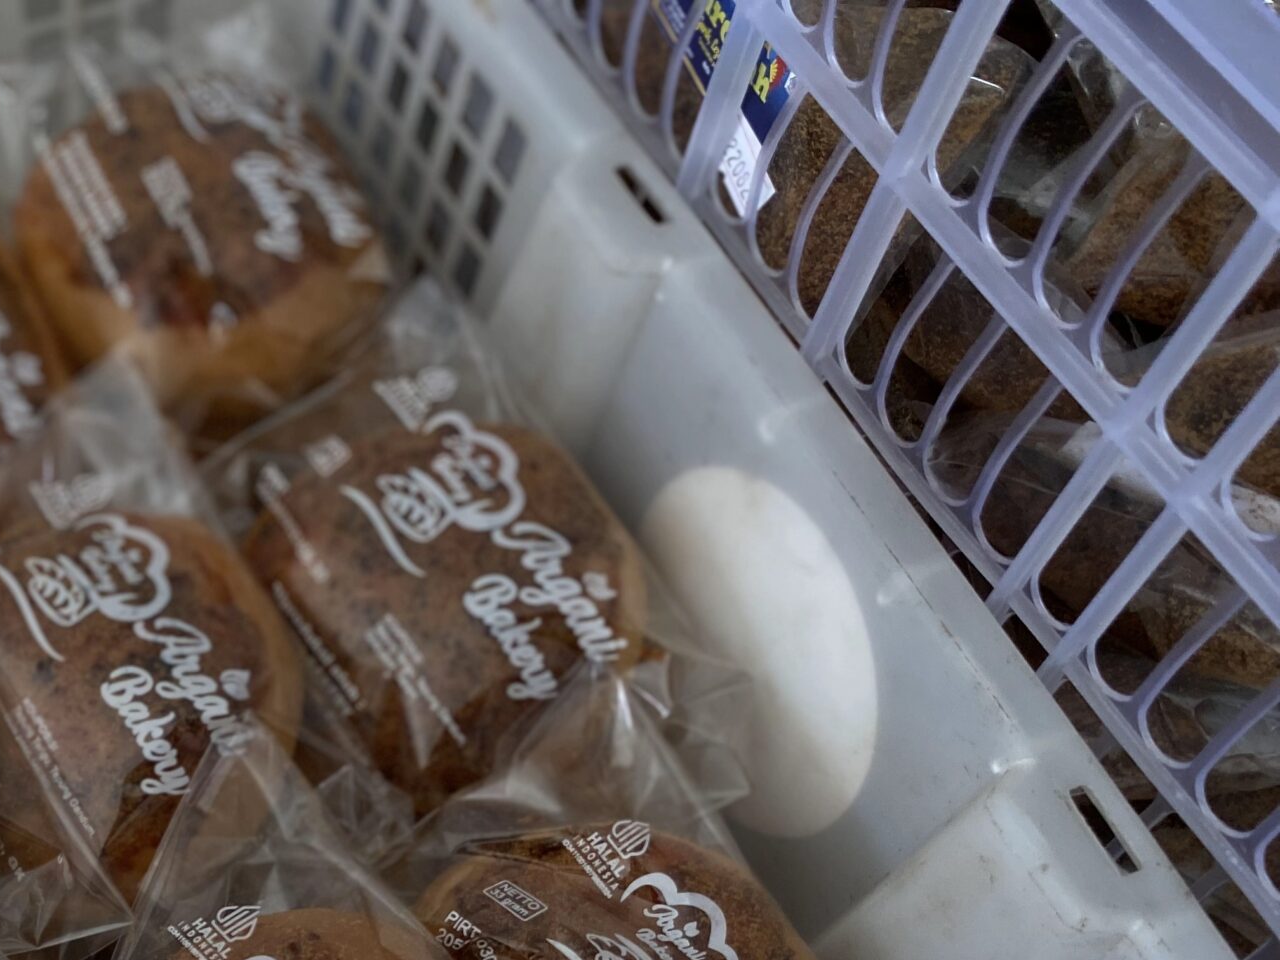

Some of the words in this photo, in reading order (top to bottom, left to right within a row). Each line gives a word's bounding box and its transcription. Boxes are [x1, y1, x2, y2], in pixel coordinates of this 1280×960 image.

[492, 522, 628, 663] Argani
[464, 574, 558, 699] Bakery
[101, 665, 191, 796] Bakery
[573, 835, 620, 891] INDONESIA
[587, 831, 627, 879] HALAL
[499, 883, 541, 911] NETTO
[191, 917, 232, 960] HALAL
[444, 910, 482, 940] PIRT
